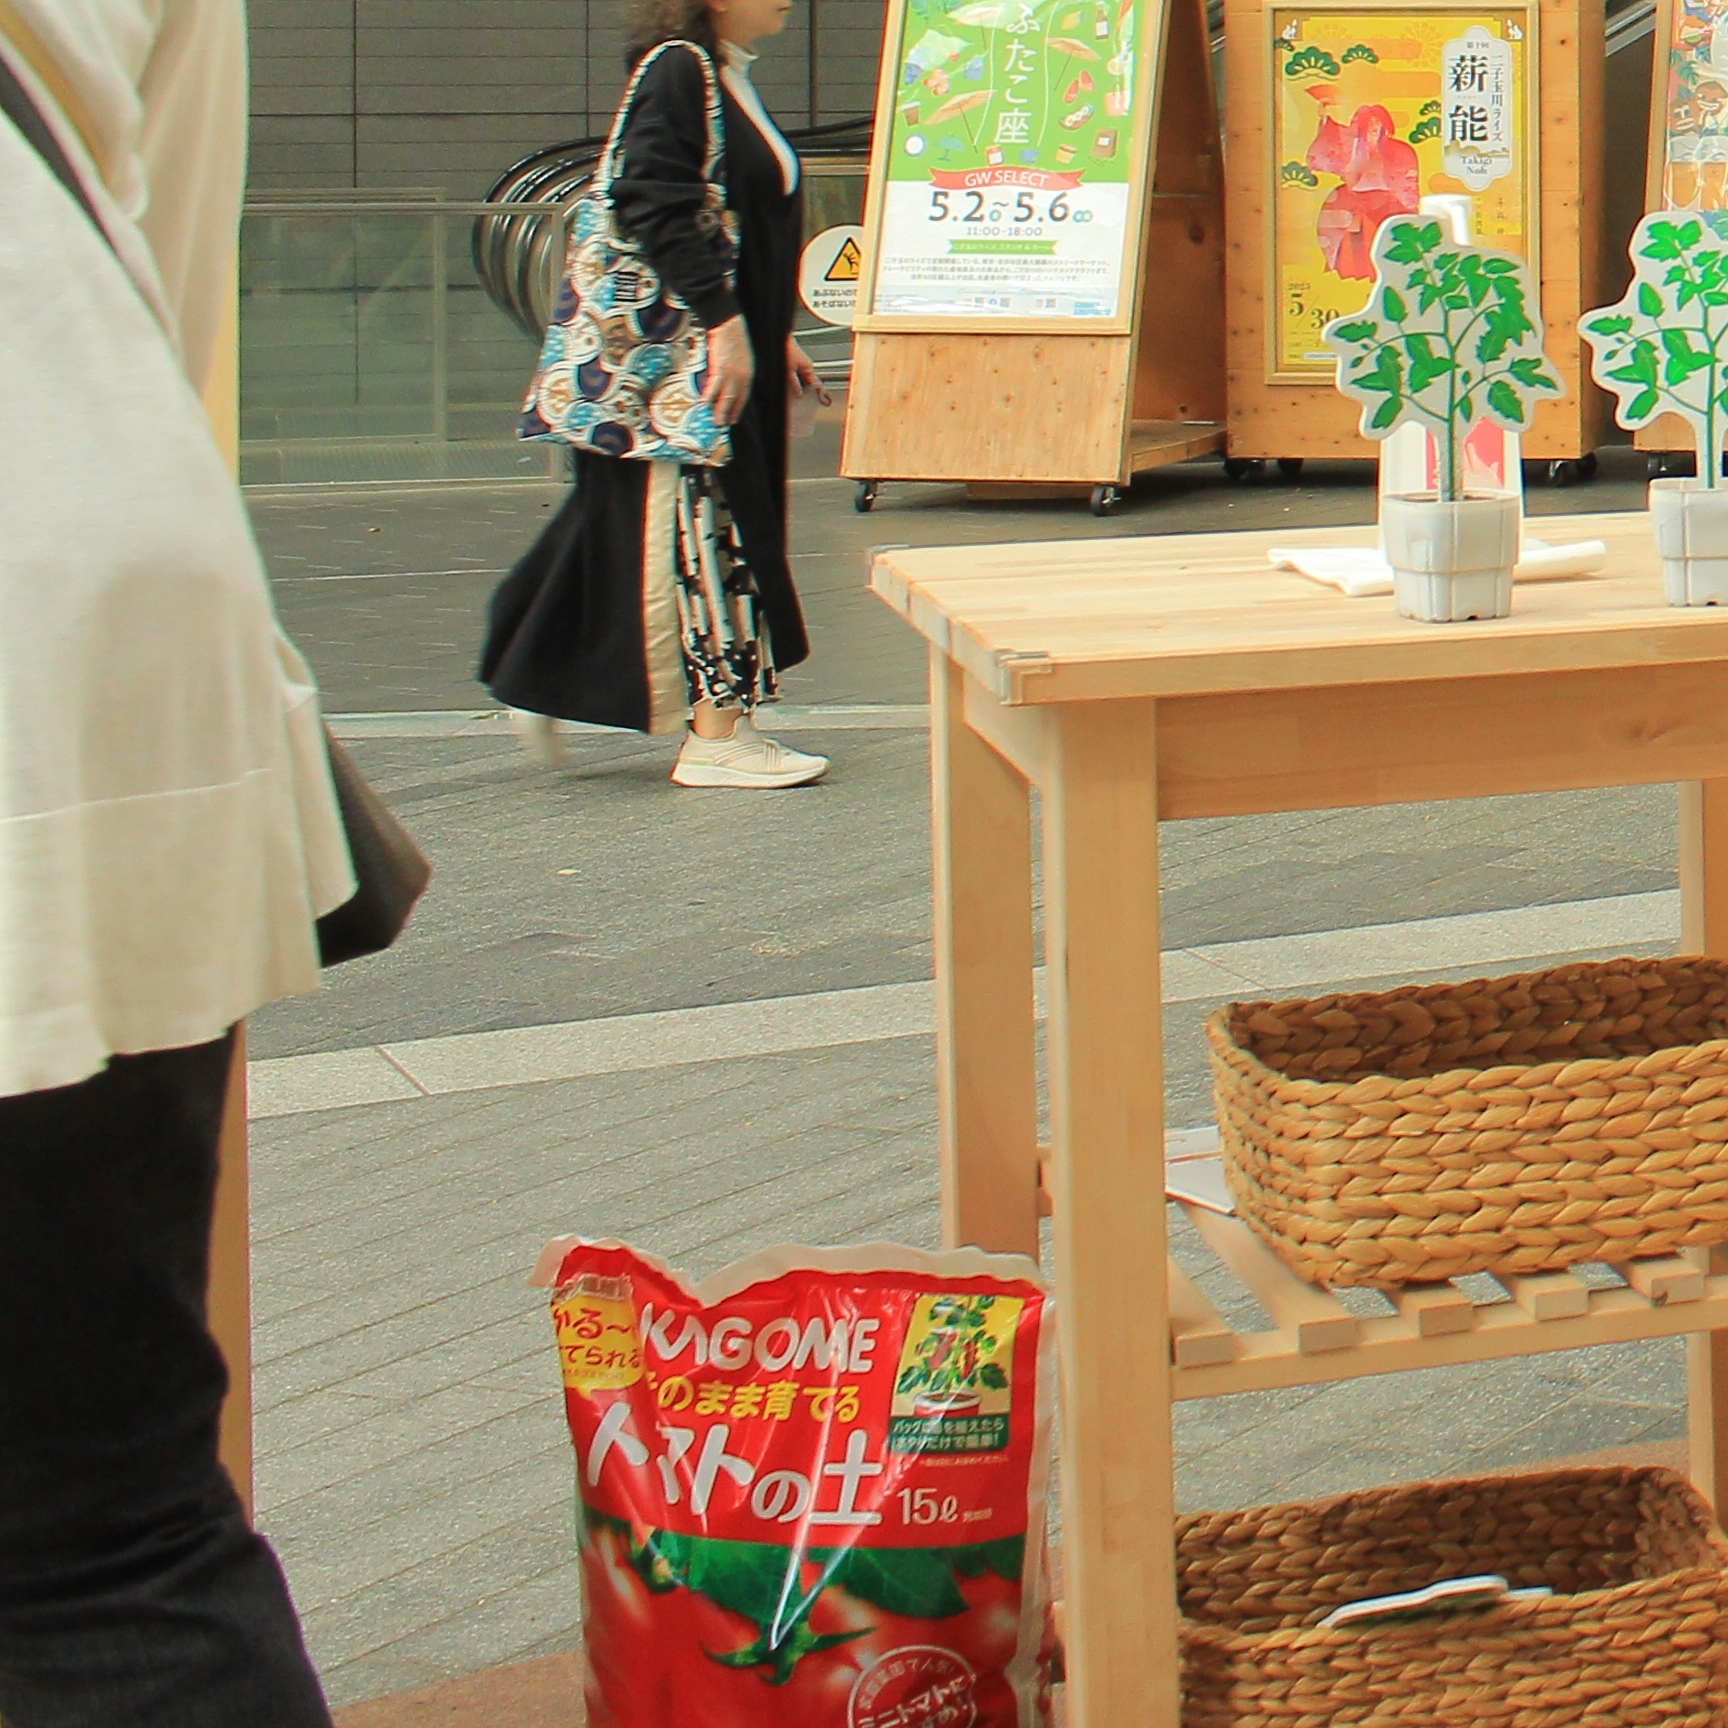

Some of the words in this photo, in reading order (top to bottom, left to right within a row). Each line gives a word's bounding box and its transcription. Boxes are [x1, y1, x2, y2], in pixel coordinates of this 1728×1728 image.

[993, 4, 1042, 144] ふたこ座
[1490, 55, 1504, 143] 二子玉川ライズ
[964, 171, 991, 186] GW
[994, 170, 1048, 187] SELECT
[1460, 154, 1493, 169] Takigi
[1466, 165, 1489, 175] Noh
[640, 1301, 881, 1375] KAGOME
